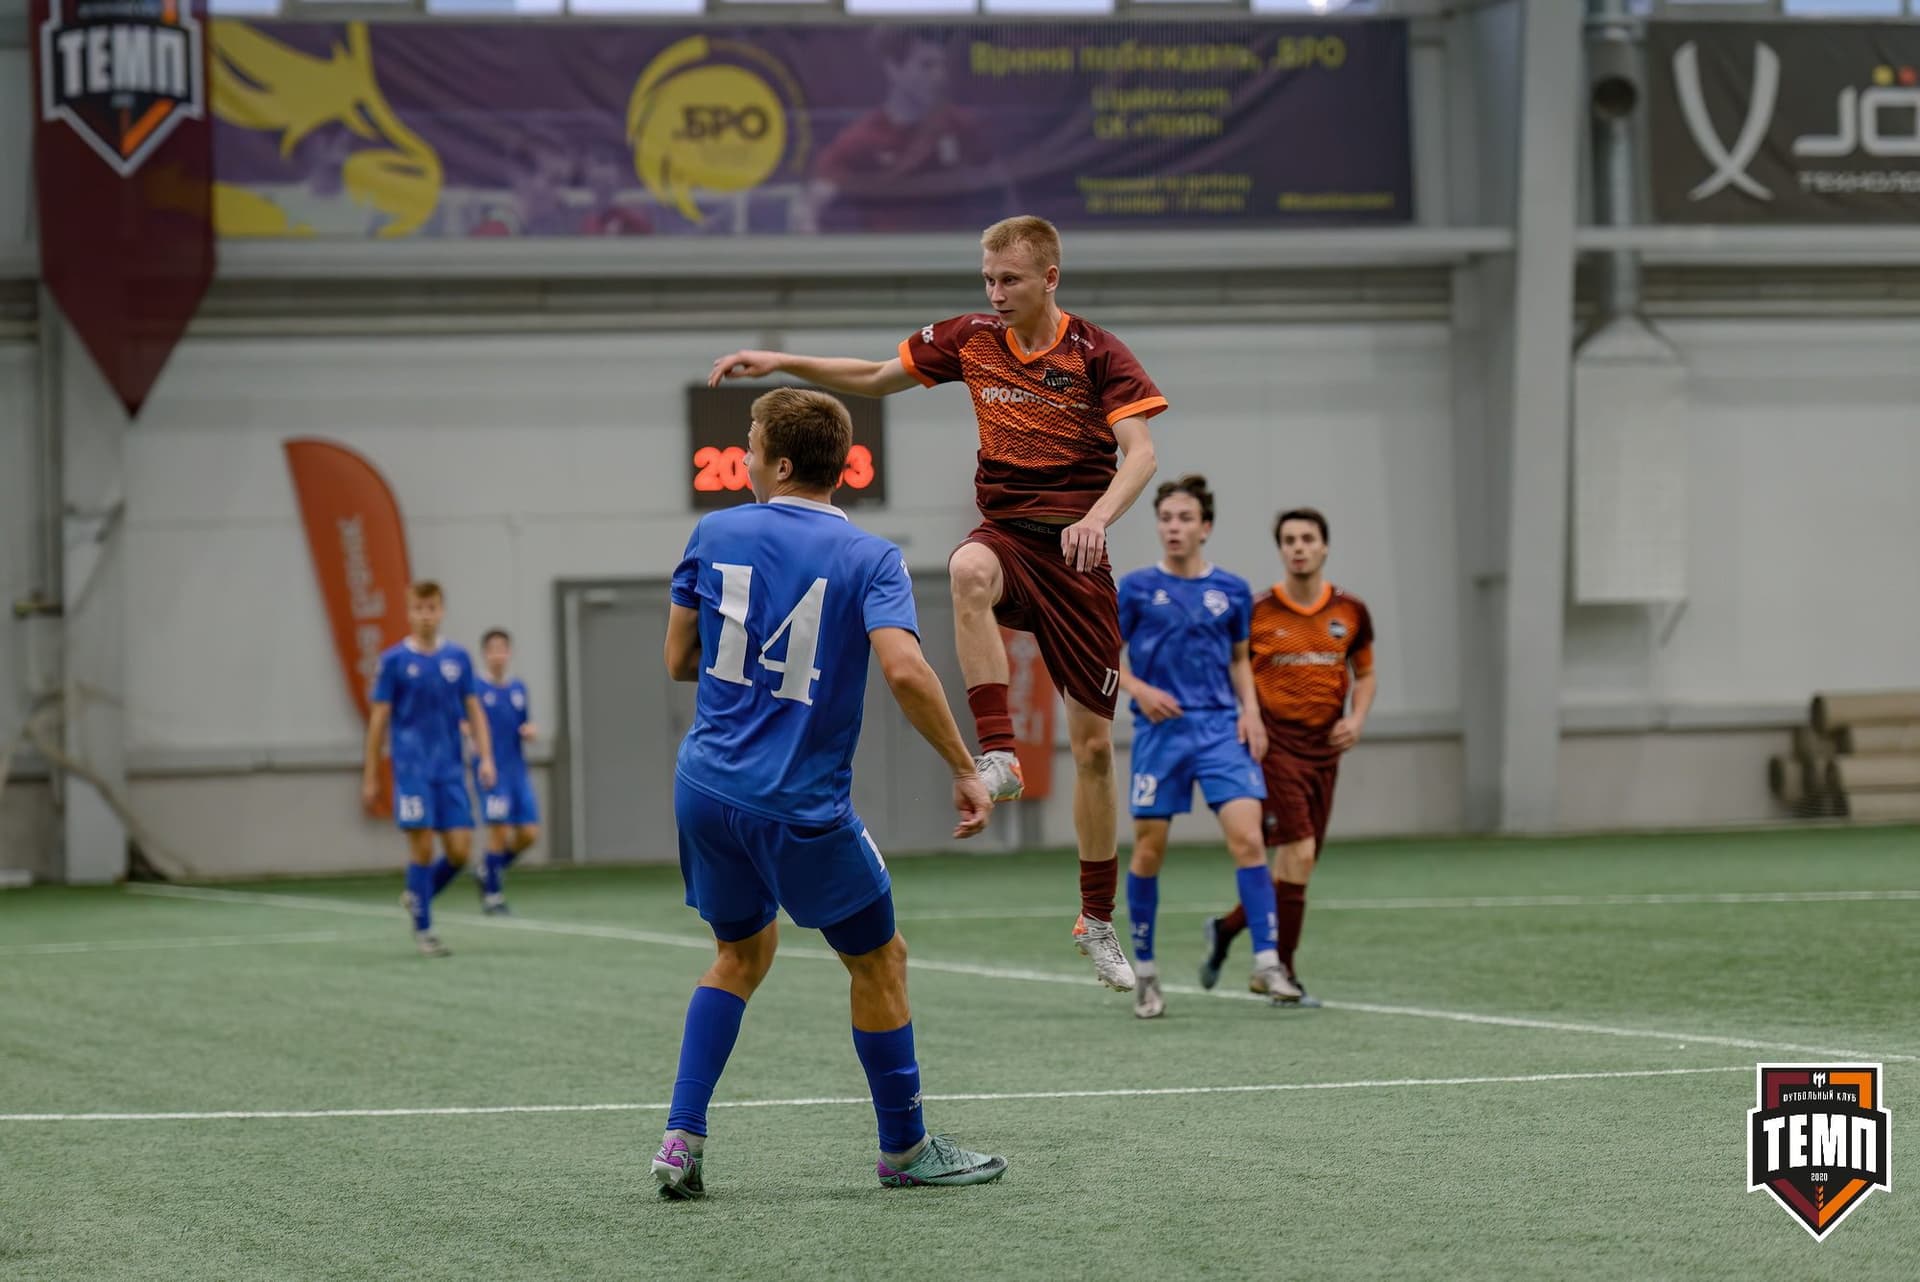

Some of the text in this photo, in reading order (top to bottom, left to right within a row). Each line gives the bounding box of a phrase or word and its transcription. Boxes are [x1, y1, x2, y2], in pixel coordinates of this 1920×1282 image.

[57, 24, 188, 97] ТЕМП
[706, 562, 829, 707] 14
[1132, 772, 1158, 808] 12
